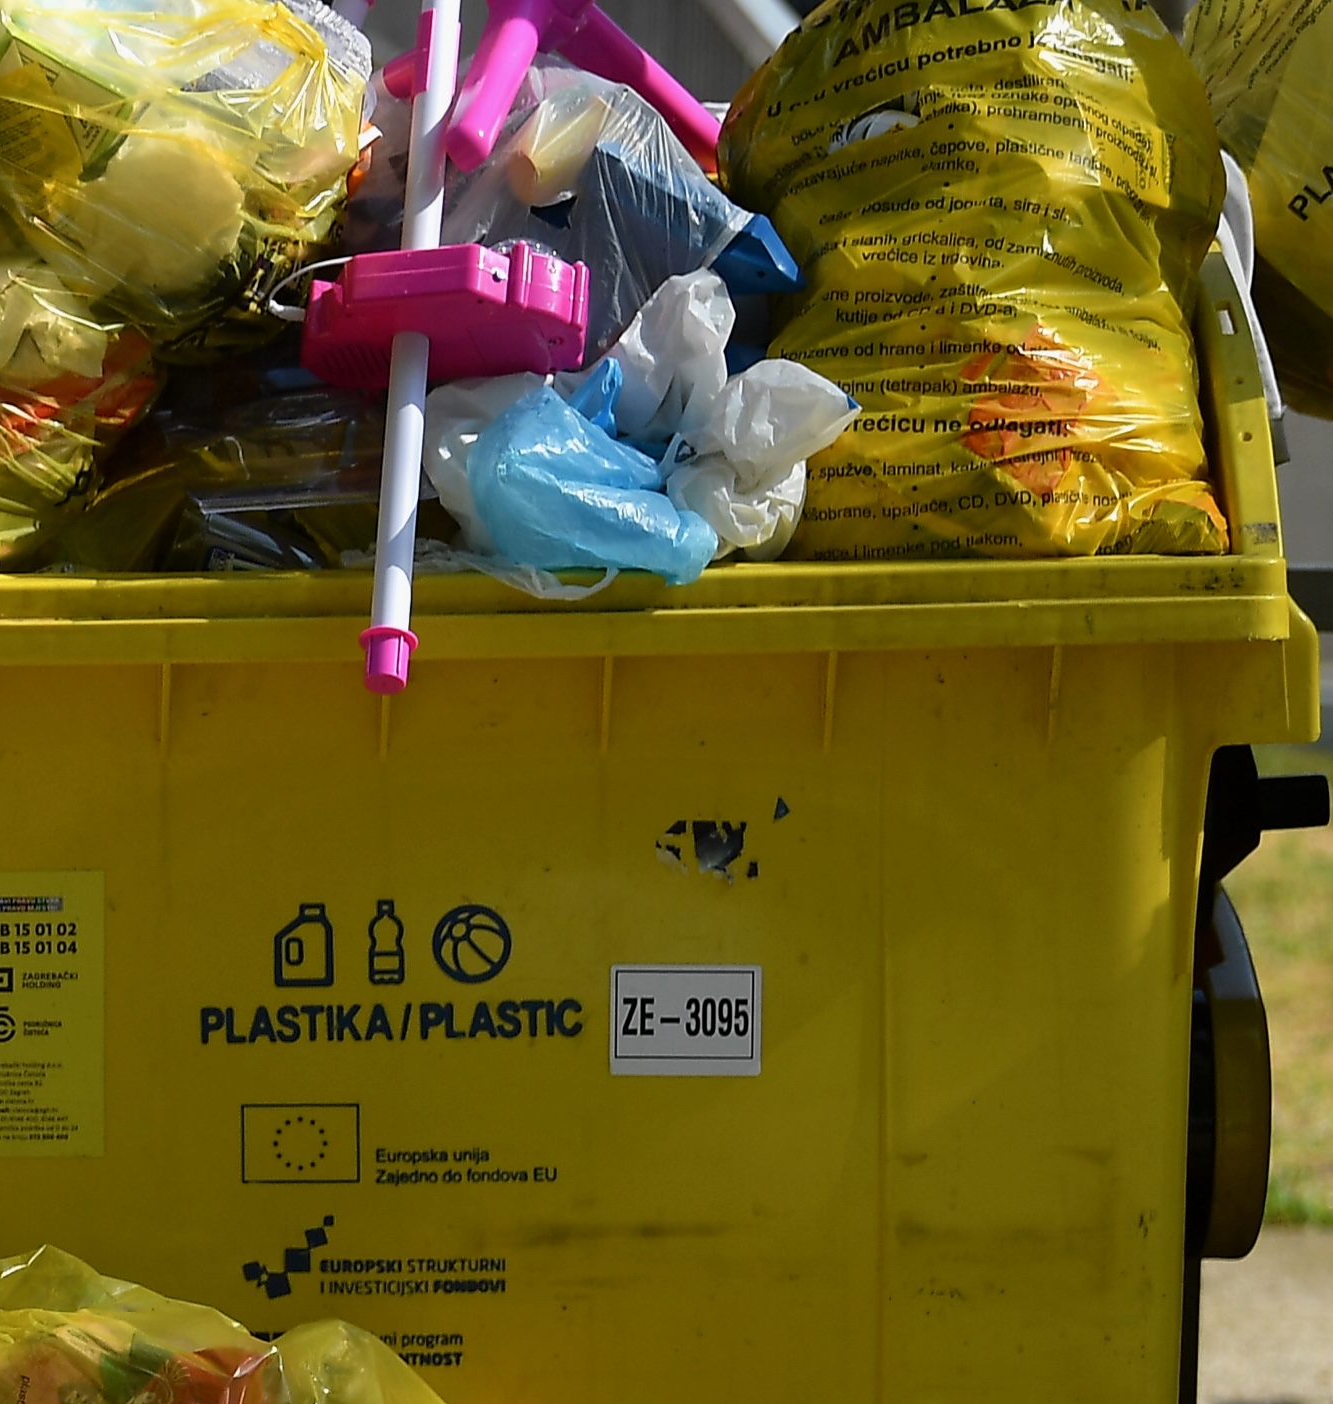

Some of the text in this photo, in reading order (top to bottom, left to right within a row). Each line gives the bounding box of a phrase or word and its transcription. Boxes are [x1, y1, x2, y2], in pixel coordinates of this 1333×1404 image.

[917, 34, 1023, 70] potrebno
[930, 141, 991, 157] čepove,
[902, 231, 979, 250] grickalica,
[862, 249, 918, 265] vrećice
[854, 338, 1001, 356] od hrane limenke
[880, 379, 958, 396] (tetrapak)
[934, 418, 962, 434] ne
[819, 461, 944, 480] spužve, laminat,
[994, 491, 1038, 507] DVD,
[15, 923, 30, 937] 15
[35, 923, 52, 937] 01
[56, 923, 77, 937] 02
[15, 941, 30, 954] 15
[35, 941, 52, 954] 01
[56, 941, 77, 954] 04
[200, 1002, 393, 1044] PLASTIKA
[420, 1000, 583, 1040] PLASTIC
[376, 1148, 490, 1164] Europska unija
[376, 1167, 558, 1185] Zajedno do fondova EU
[319, 1259, 506, 1273] EUROPSKI STRUKTURNI
[329, 1281, 429, 1296] INVESTICIJSKI
[434, 1280, 506, 1293] FONDOVI
[401, 1333, 464, 1349] program
